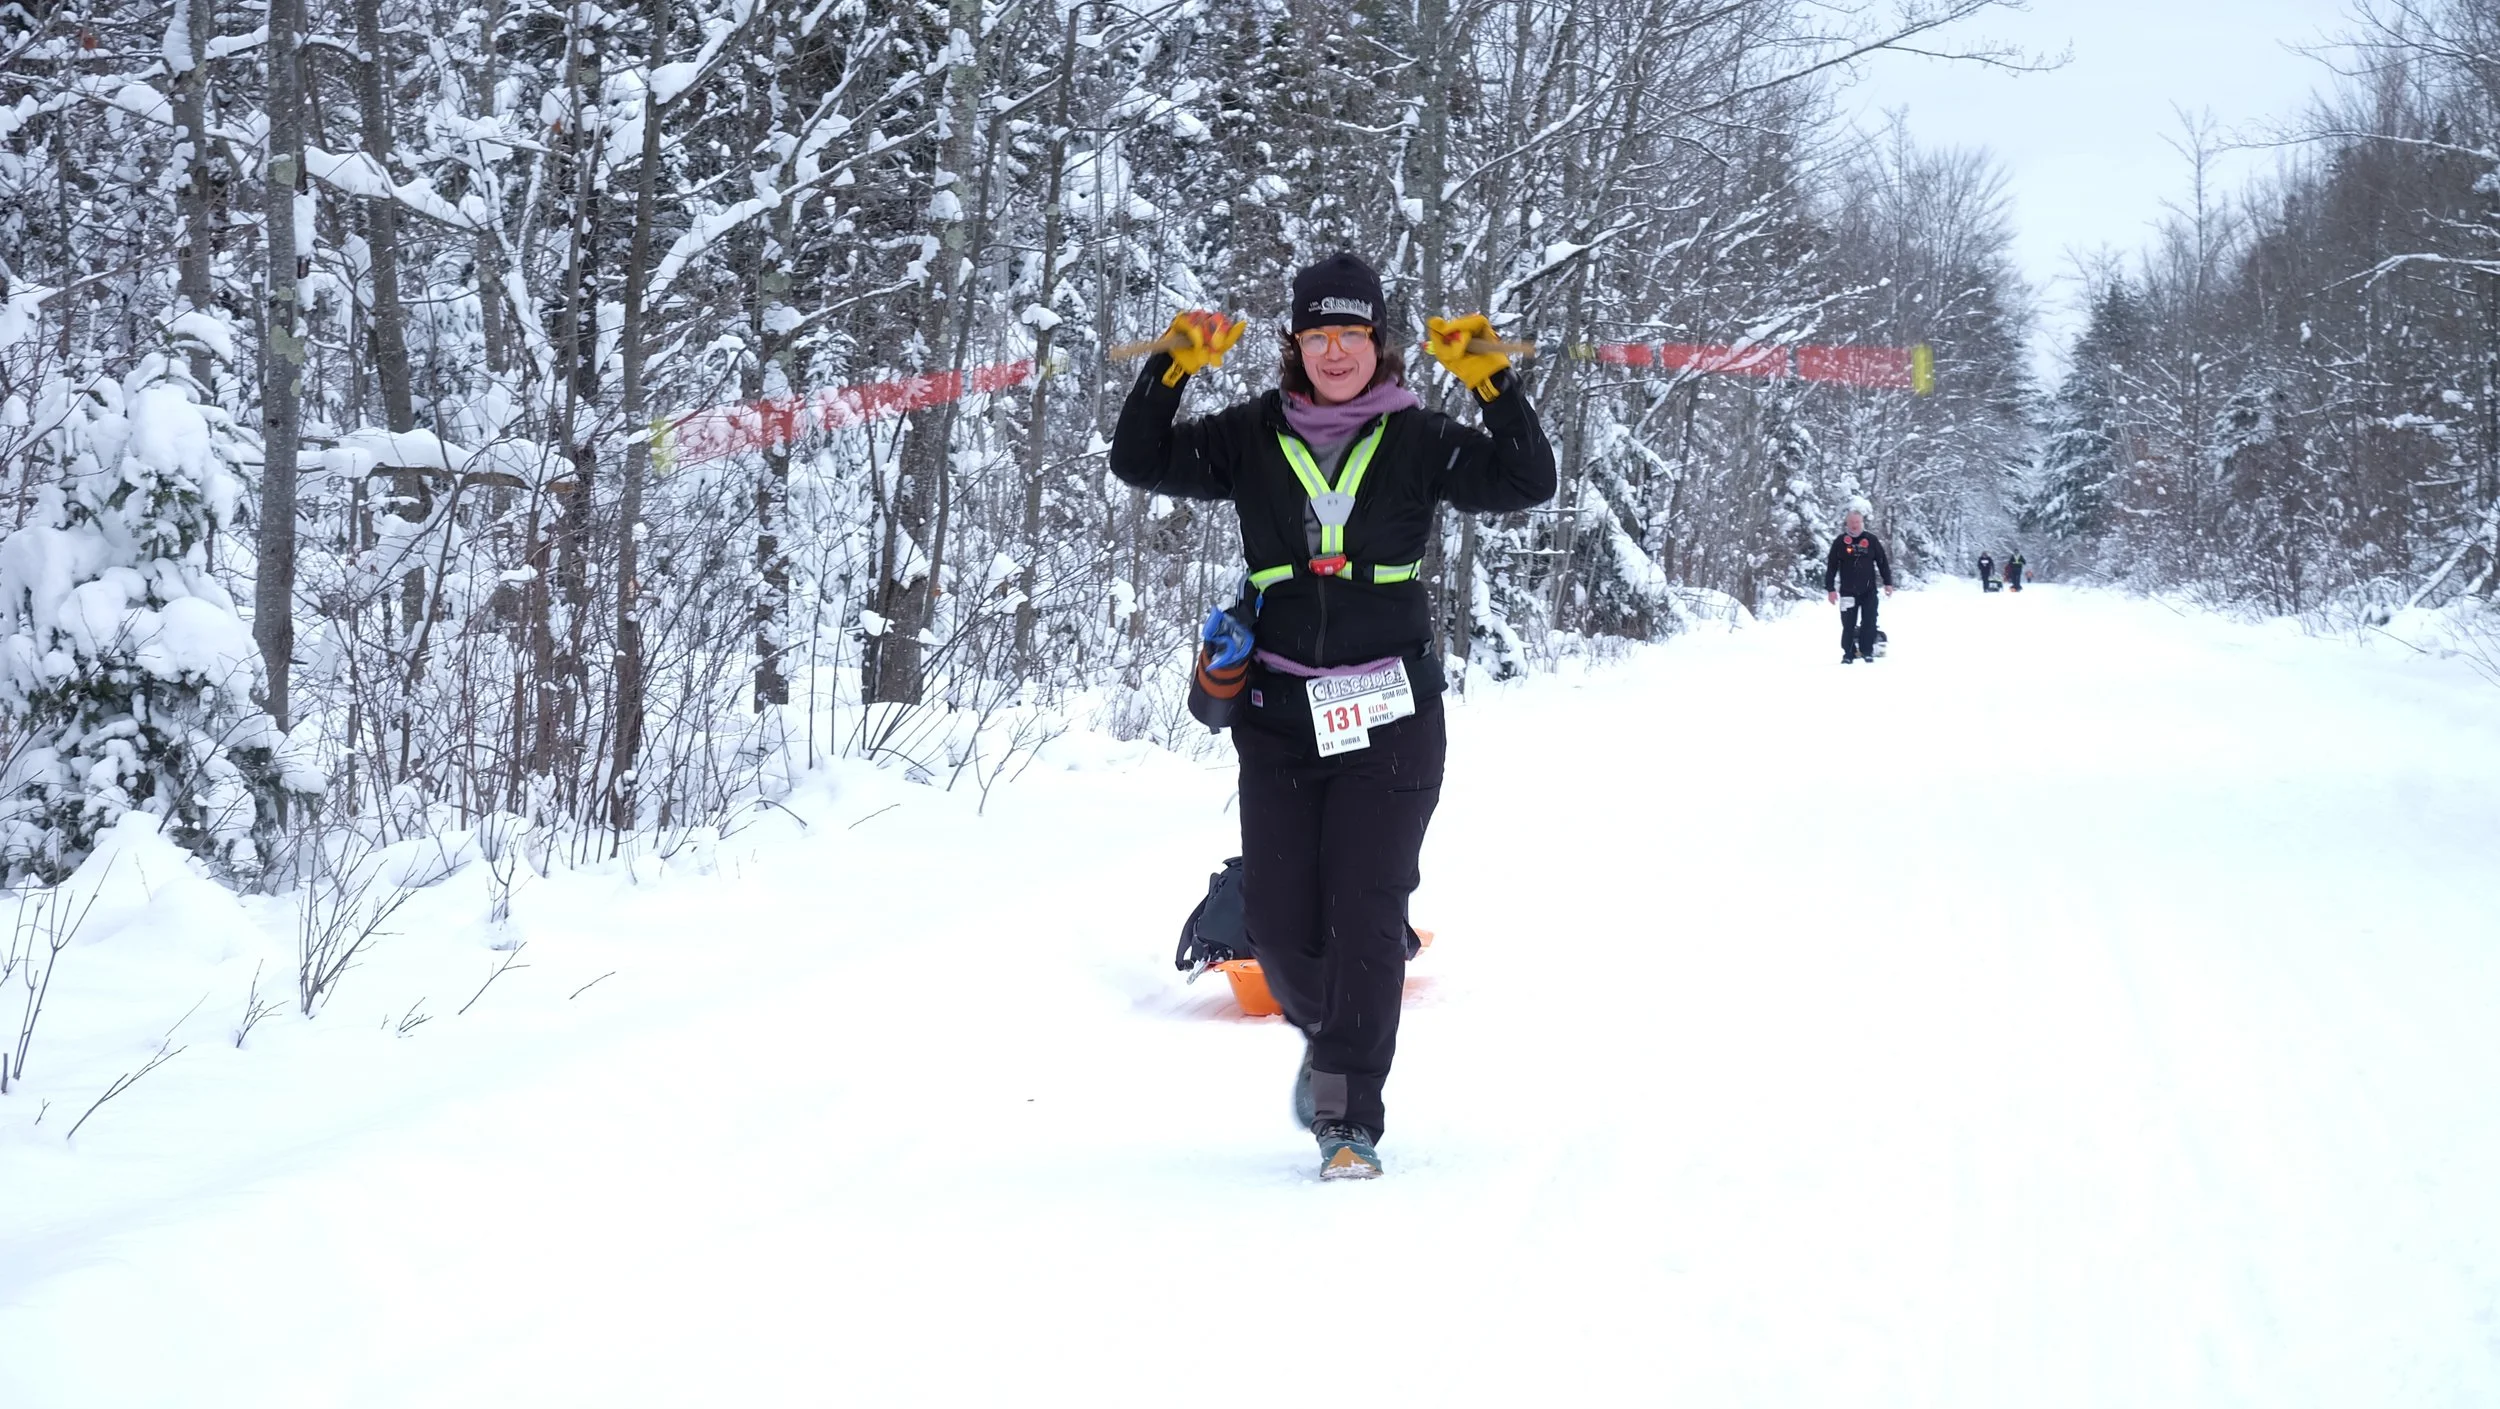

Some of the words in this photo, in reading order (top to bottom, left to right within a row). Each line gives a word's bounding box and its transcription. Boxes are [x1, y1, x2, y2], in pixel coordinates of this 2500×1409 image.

[1396, 687, 1409, 698] RUN
[1368, 703, 1388, 714] ELENA
[1323, 703, 1362, 733] 131
[1369, 711, 1394, 724] HAYNES
[1321, 741, 1334, 752] 131
